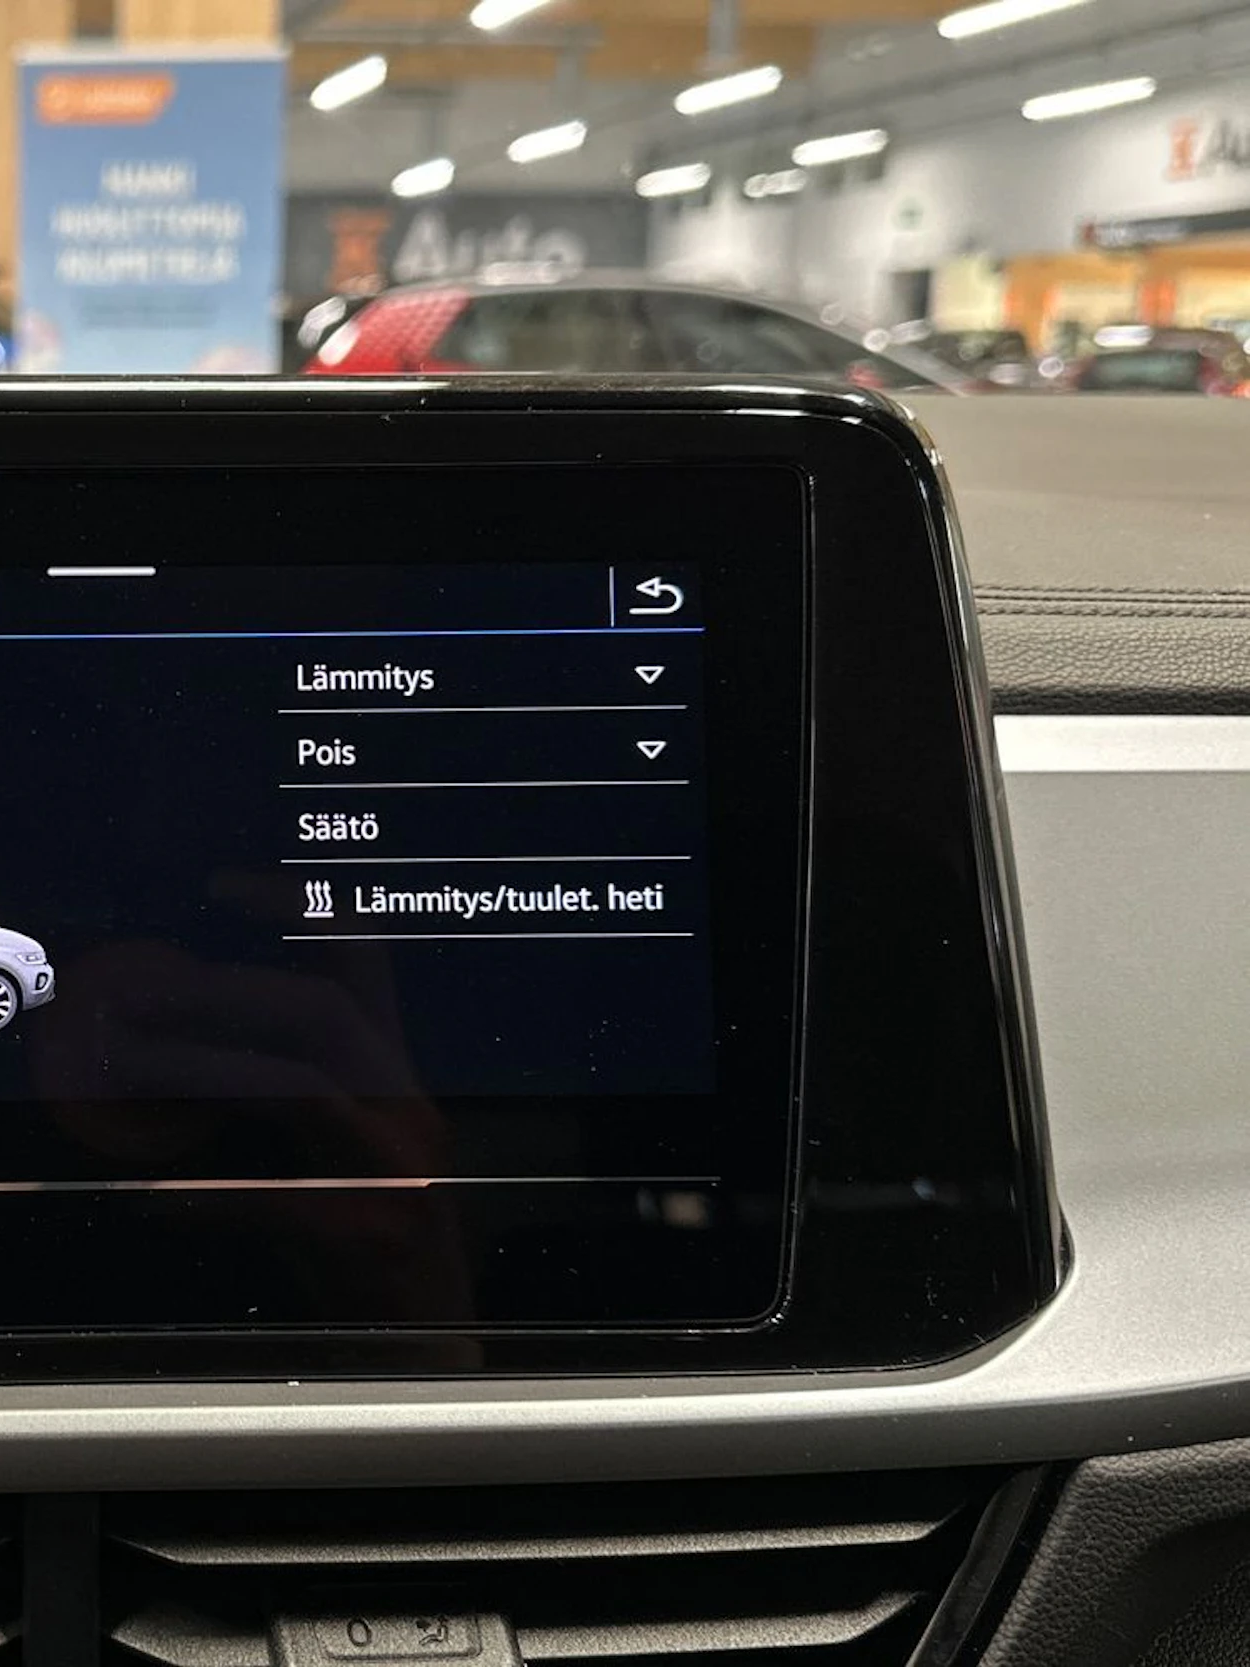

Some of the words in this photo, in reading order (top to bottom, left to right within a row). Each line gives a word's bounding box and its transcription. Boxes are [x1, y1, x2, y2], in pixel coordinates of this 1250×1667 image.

[296, 663, 435, 697] Lämmitys
[297, 738, 356, 766] Pois
[298, 812, 379, 841] Säätö
[355, 883, 600, 920] Lämmitys/tuulet.
[607, 882, 664, 911] heti
